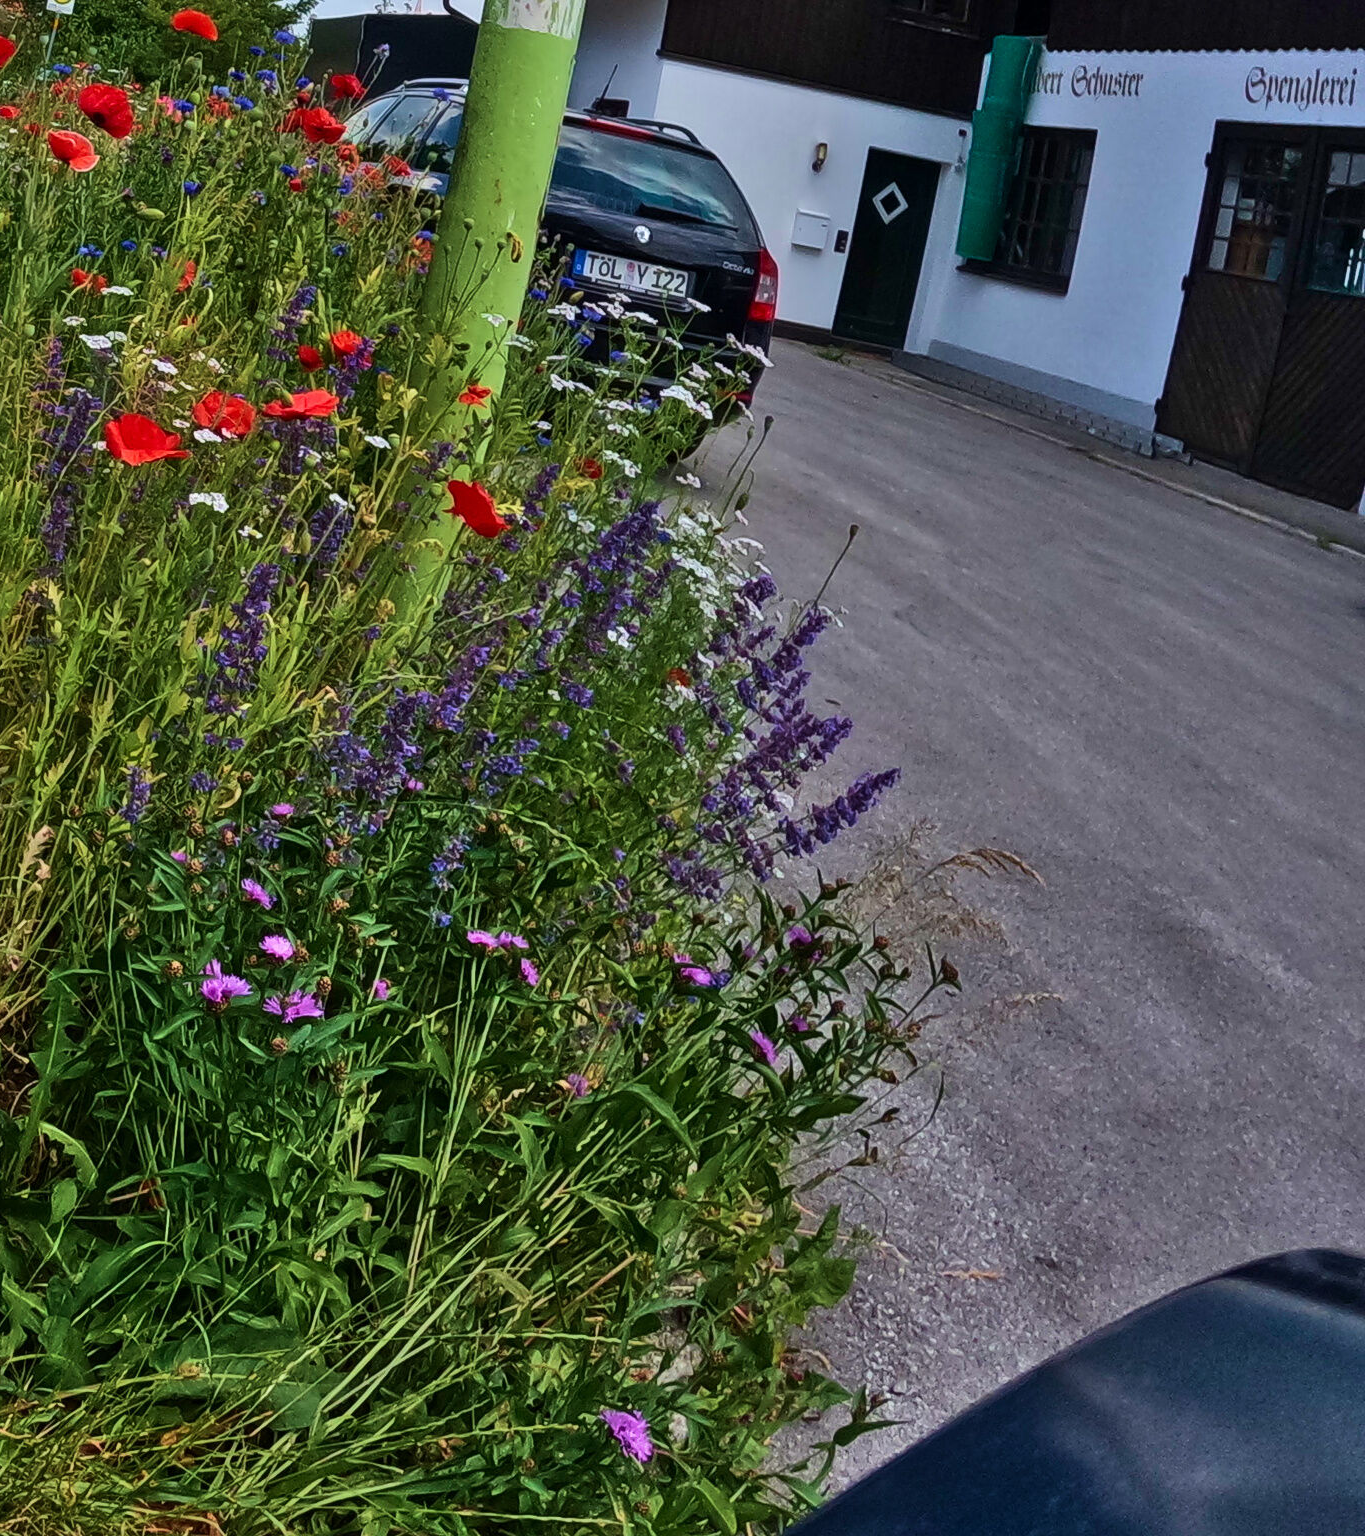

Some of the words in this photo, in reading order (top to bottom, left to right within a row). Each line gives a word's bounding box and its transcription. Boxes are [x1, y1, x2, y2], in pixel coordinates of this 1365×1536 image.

[1071, 65, 1144, 100] Schuster
[1245, 66, 1358, 112] Spenglerei
[637, 264, 649, 284] Y
